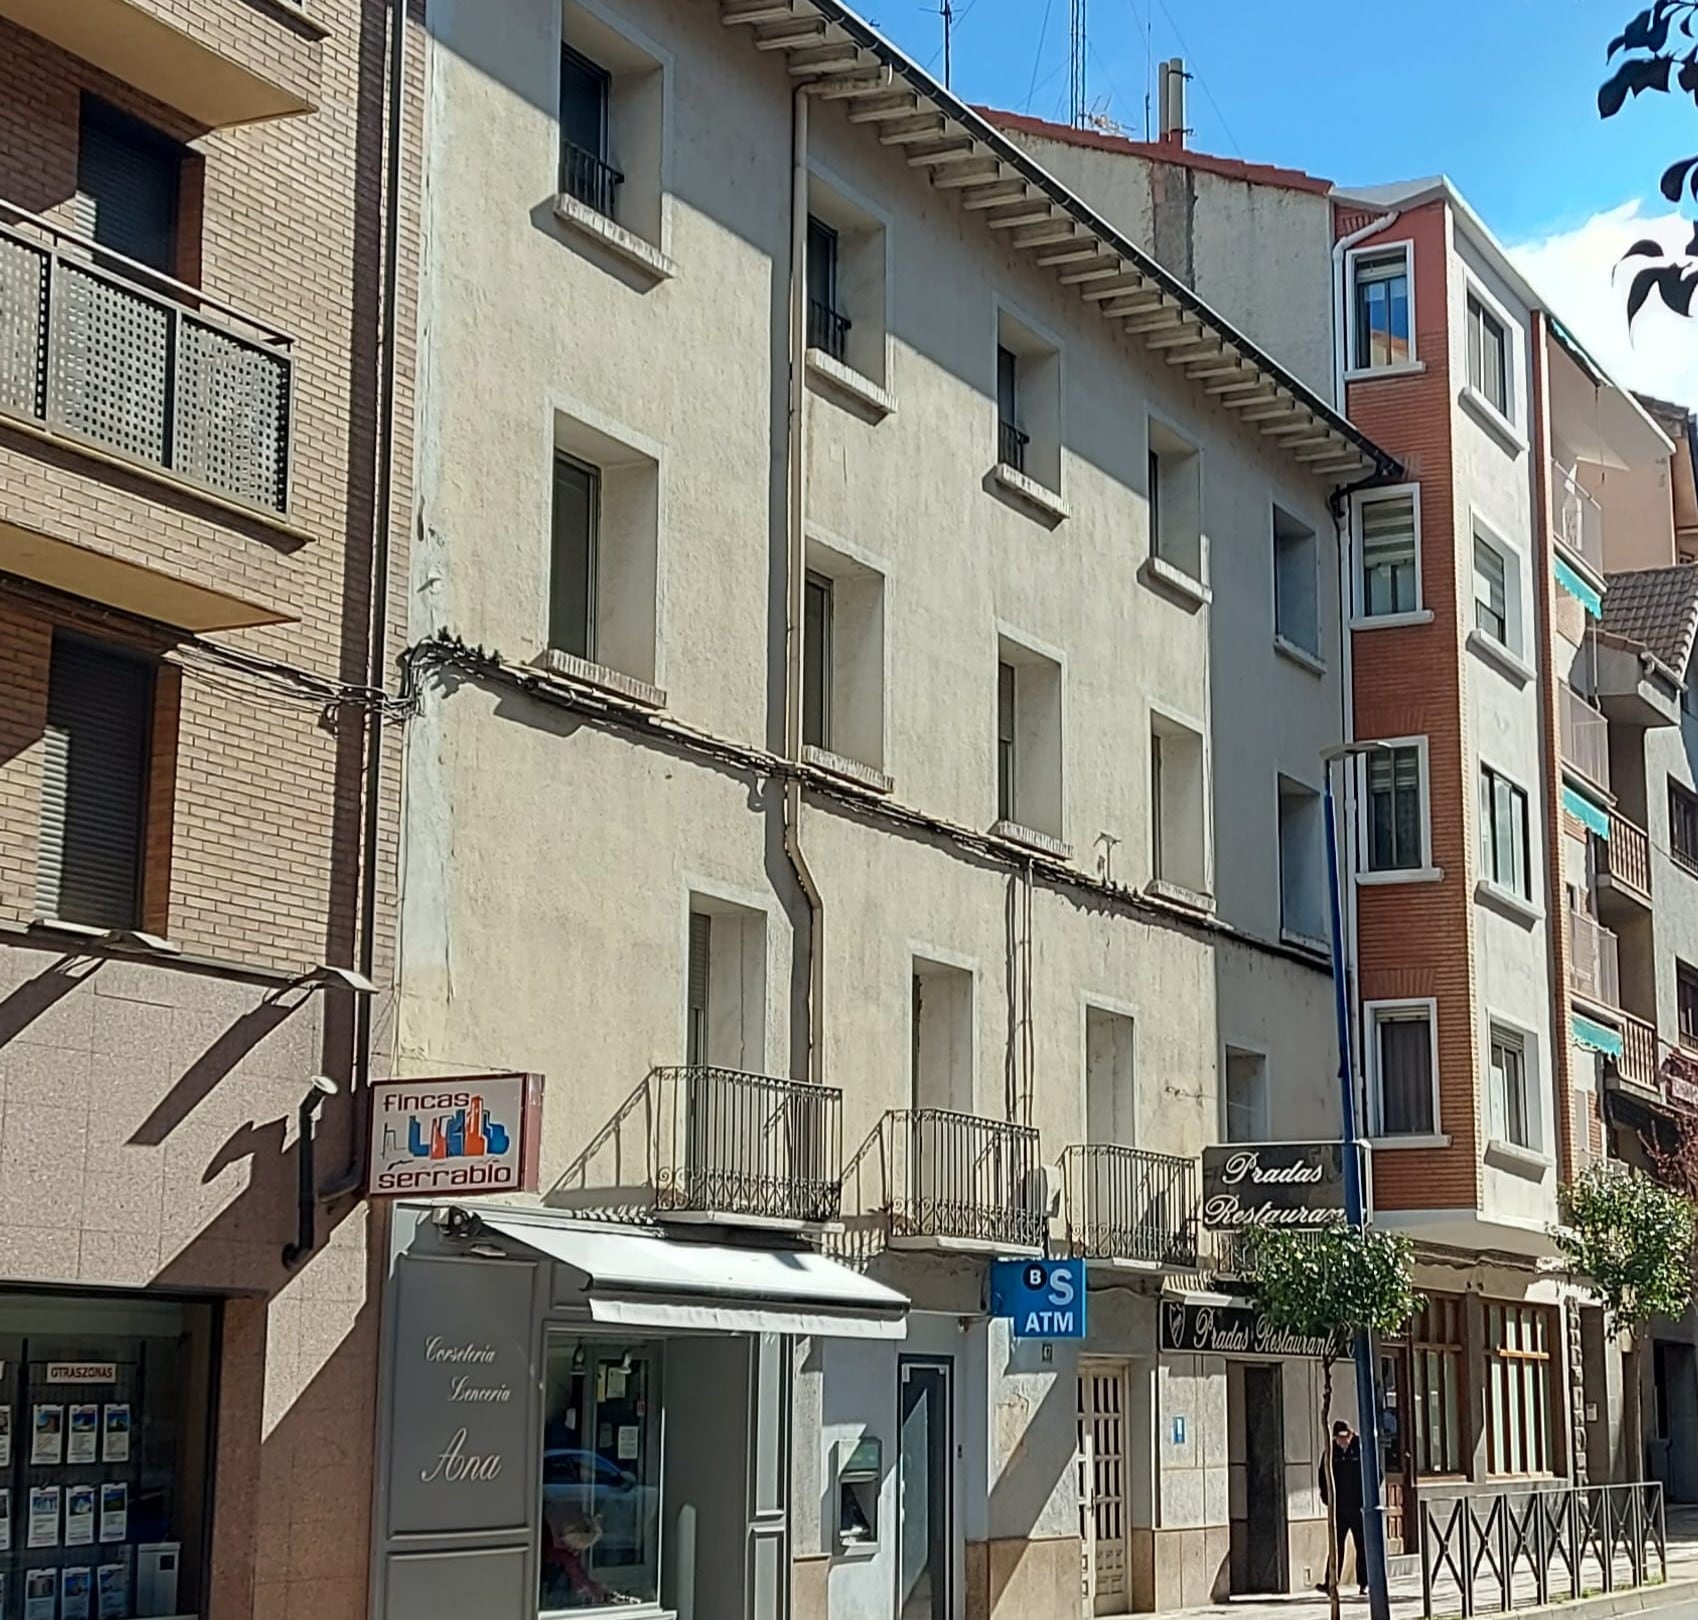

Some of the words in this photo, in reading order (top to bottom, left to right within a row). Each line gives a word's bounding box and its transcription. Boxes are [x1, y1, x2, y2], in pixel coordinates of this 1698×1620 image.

[384, 1092, 470, 1112] fincas
[378, 1163, 511, 1189] serrablo
[1222, 1151, 1323, 1185] Pradas
[1029, 1269, 1042, 1285] B
[1048, 1268, 1074, 1306] S
[1025, 1311, 1073, 1333] ATM
[1193, 1307, 1249, 1351] Pradas
[421, 1427, 502, 1482] Ana
